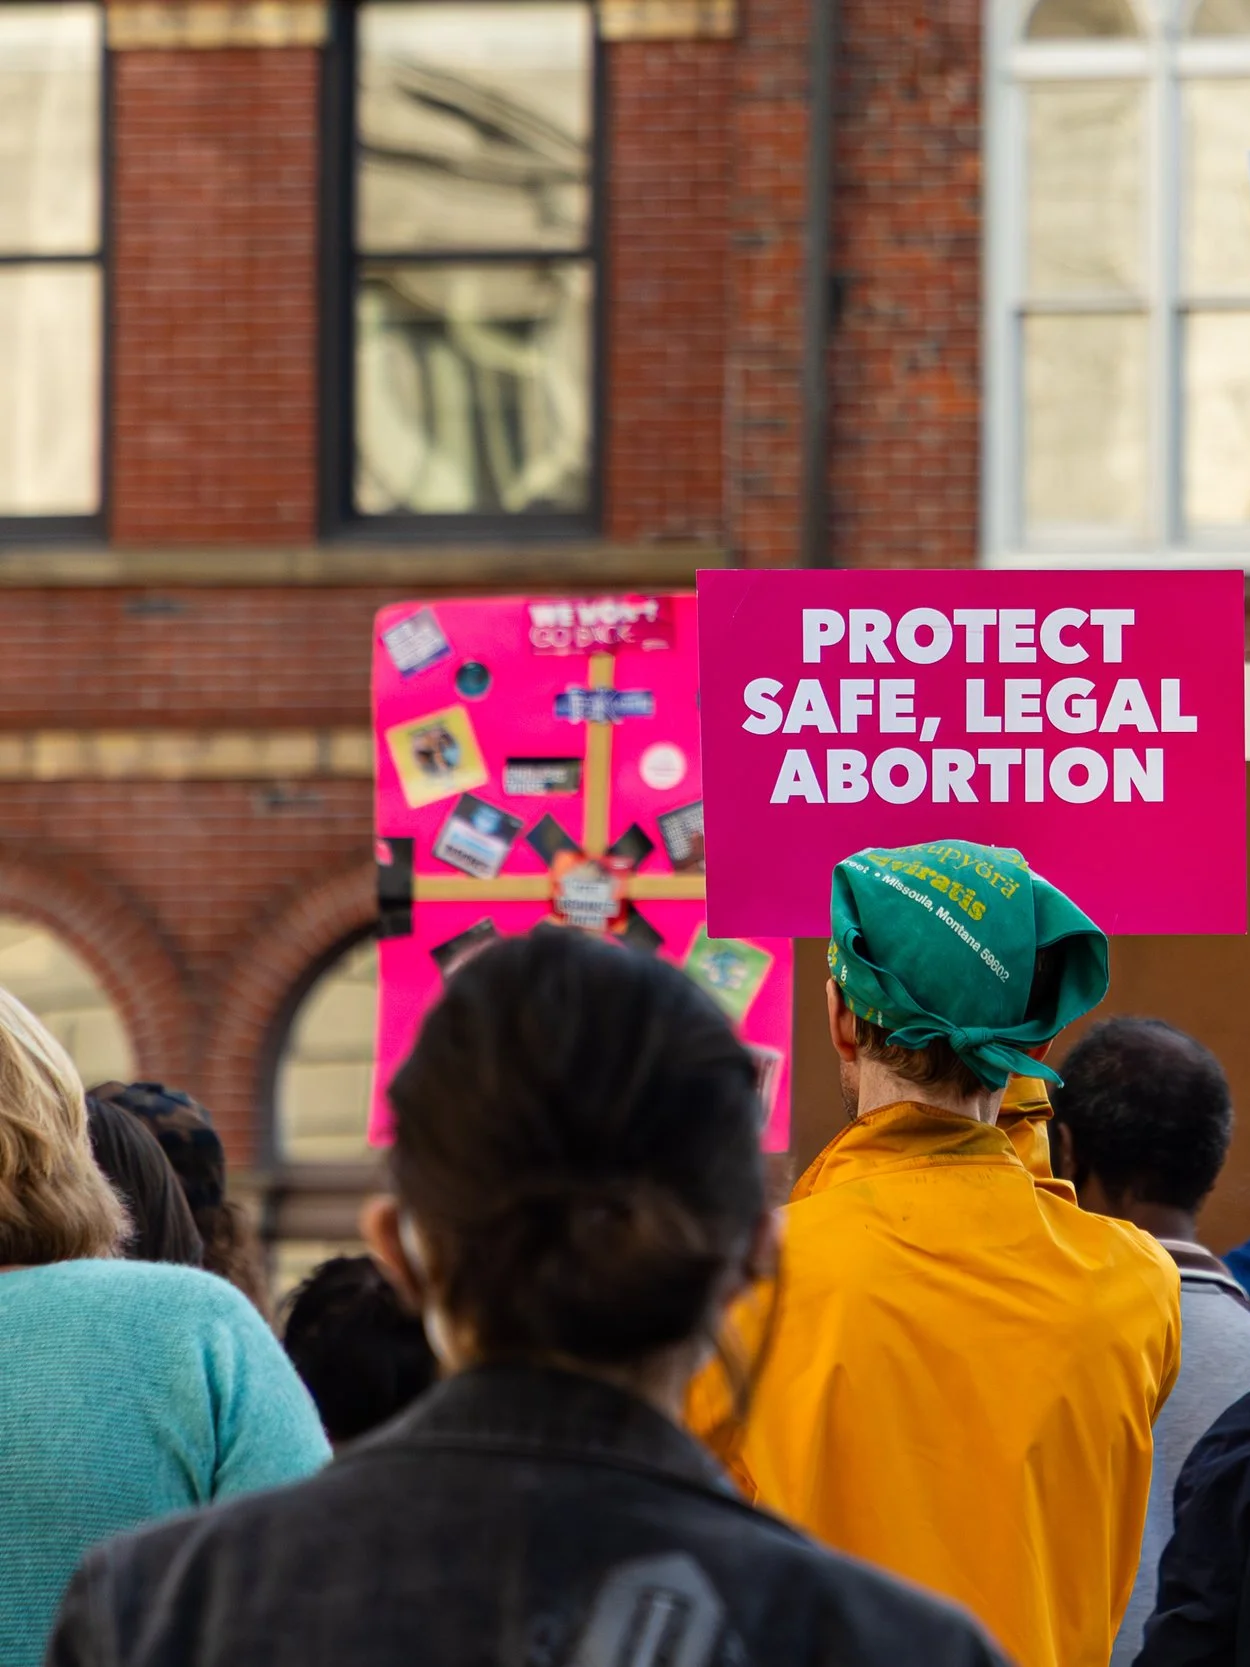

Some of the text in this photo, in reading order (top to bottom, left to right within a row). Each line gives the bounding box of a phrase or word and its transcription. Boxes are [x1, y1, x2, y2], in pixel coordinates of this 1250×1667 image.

[802, 607, 1136, 665] PROTECT
[741, 677, 1198, 742] SAFE, LEGAL
[769, 747, 1165, 805] ABORTION
[841, 859, 1010, 983] reet Missoula, Montana 59802
